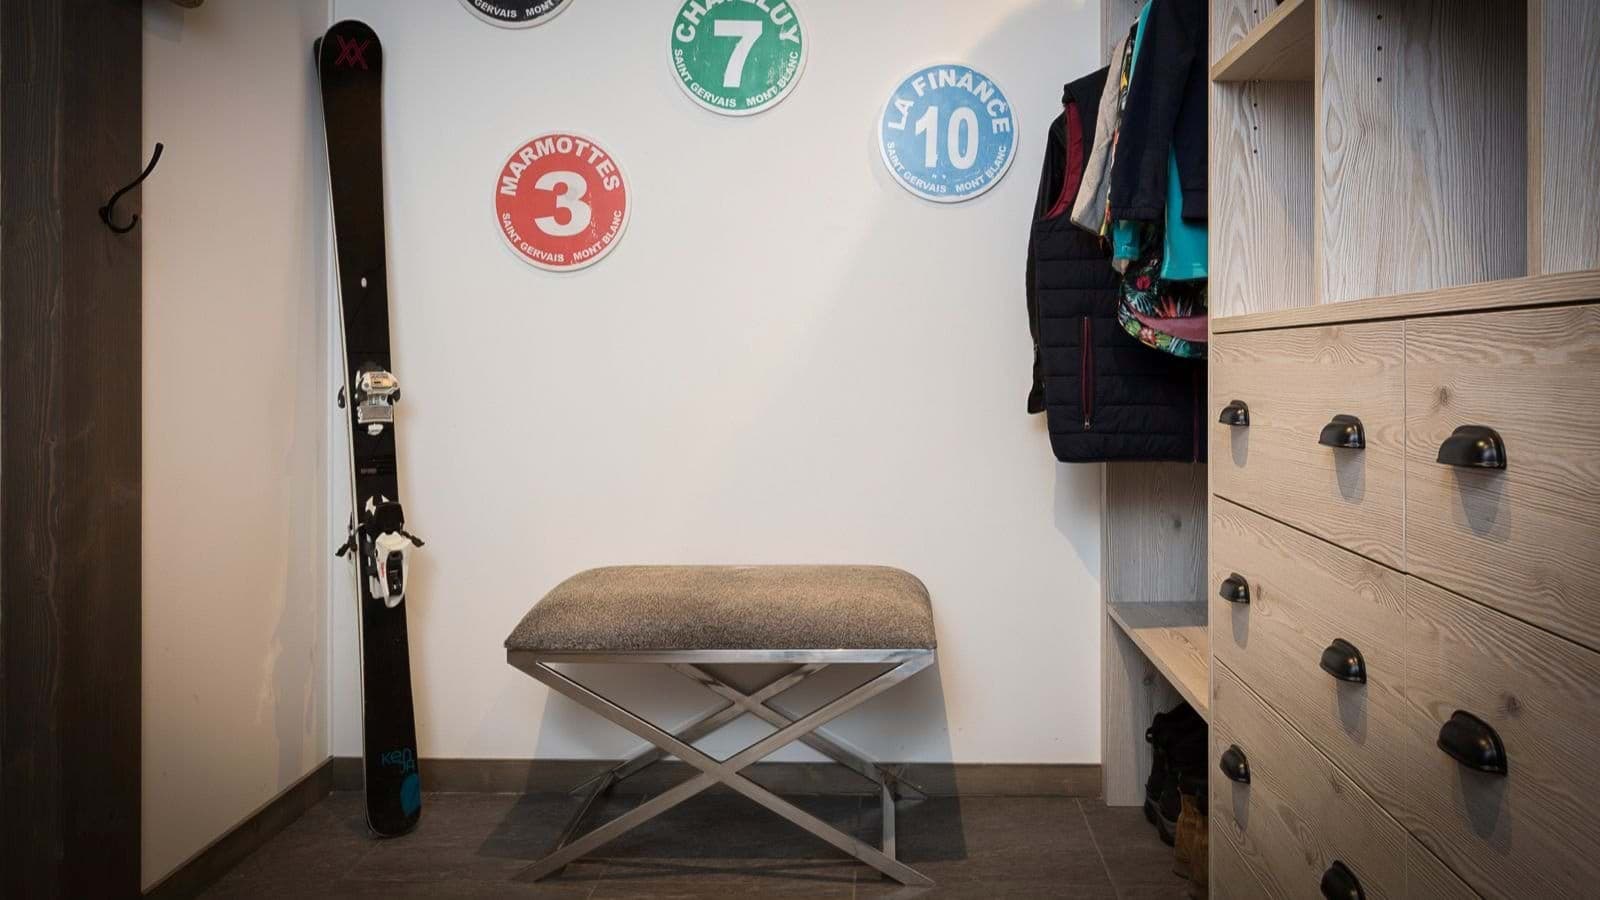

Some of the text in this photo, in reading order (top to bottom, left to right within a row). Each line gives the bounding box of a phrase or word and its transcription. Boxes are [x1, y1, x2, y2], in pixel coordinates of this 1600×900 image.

[674, 49, 799, 107] SAINT GERVAIS MONT BLANC
[714, 20, 762, 88] 7
[888, 69, 1010, 134] LA FINANCE
[500, 137, 620, 196] MARMOTTES
[887, 142, 1007, 193] SAINT GERVAIS MONT BLANC
[915, 105, 979, 170] 10
[534, 170, 592, 236] 3
[502, 210, 622, 262] SAINT GERVAIS MONT BLANC
